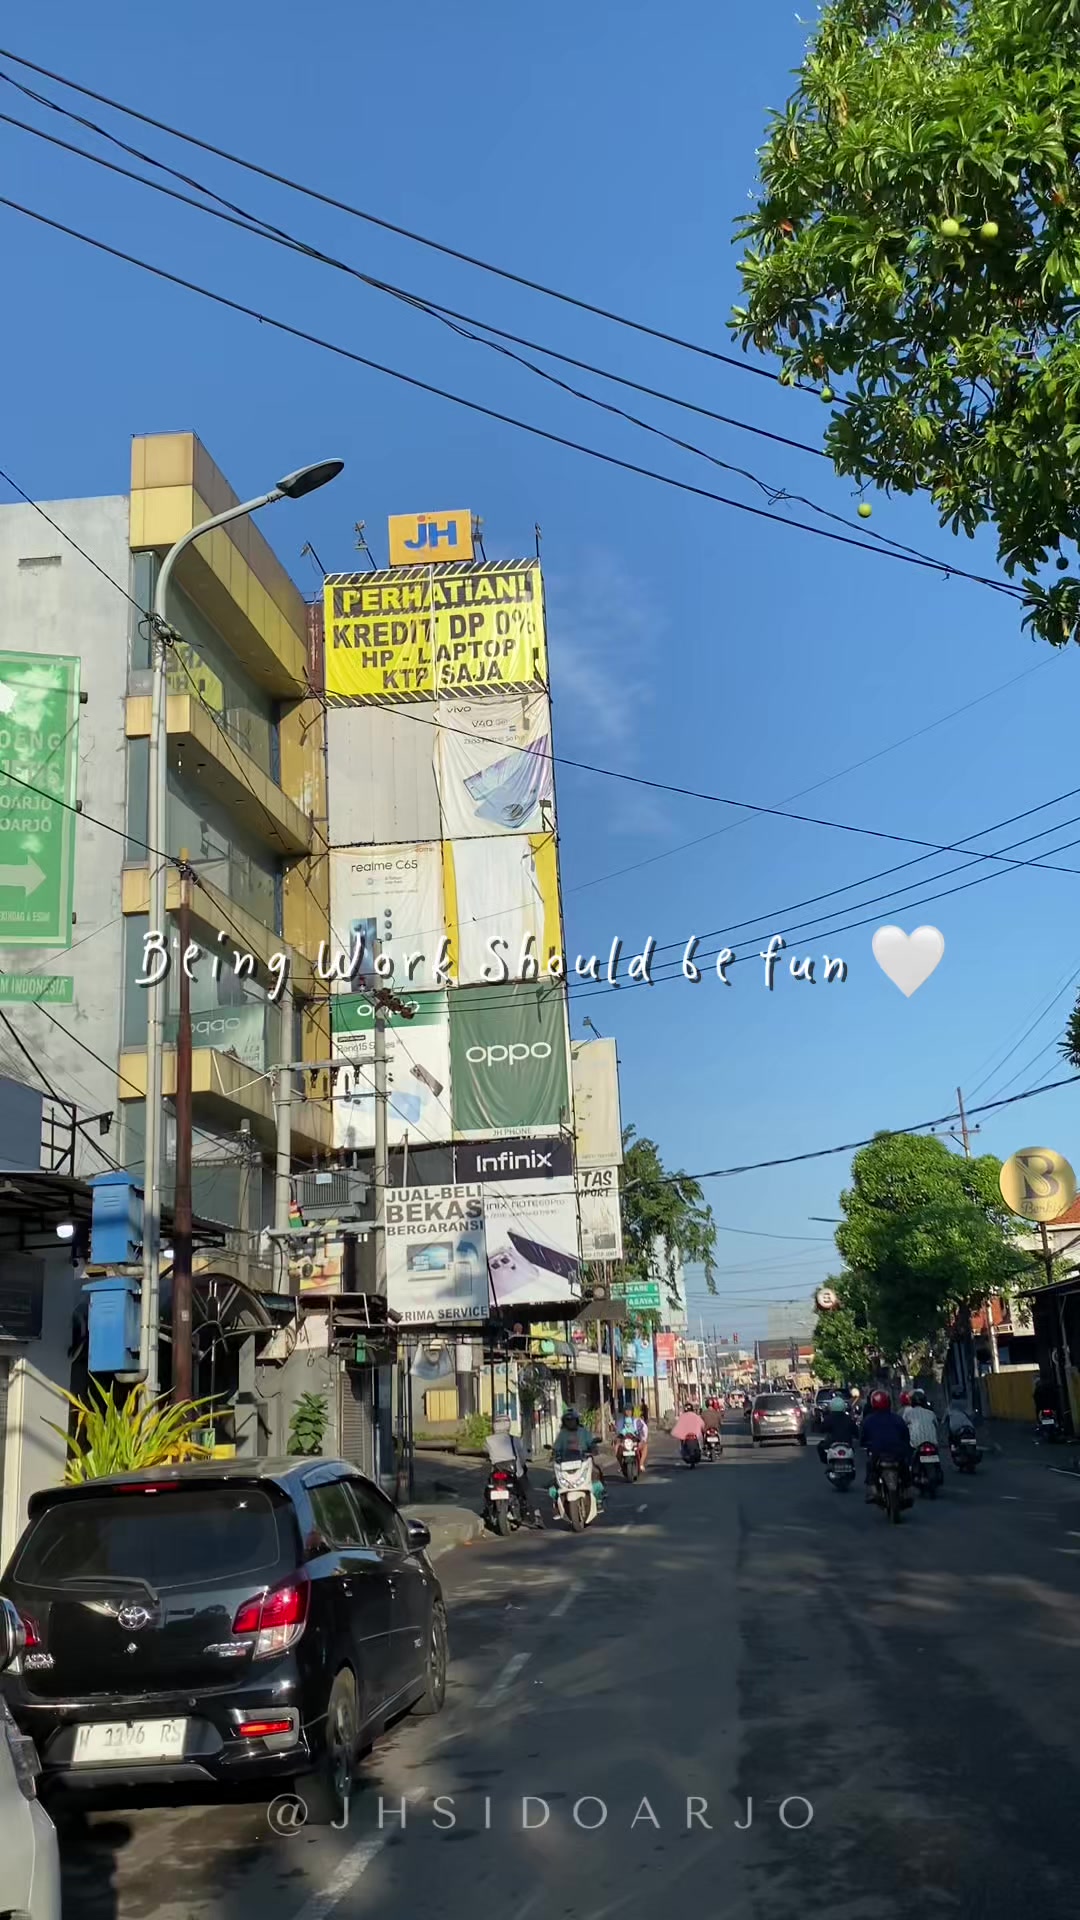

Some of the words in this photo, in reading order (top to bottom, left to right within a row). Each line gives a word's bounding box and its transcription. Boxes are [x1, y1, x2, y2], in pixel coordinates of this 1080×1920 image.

[343, 574, 527, 613] PERHATIAN!
[333, 617, 439, 649] KREDIT
[450, 612, 485, 640] DP
[496, 608, 536, 635] 0%
[362, 650, 394, 668] HP
[418, 639, 515, 665] LAPTOP
[383, 667, 429, 690] KTP
[441, 660, 503, 685] SAJA
[351, 861, 393, 873] realme
[395, 859, 418, 870] C65
[465, 1041, 552, 1067] oppo
[504, 1127, 532, 1136] PHONE
[476, 1149, 553, 1173] Infinix
[581, 1170, 613, 1188] TAS
[386, 1184, 482, 1204] JUAL-BELI
[386, 1199, 482, 1224] BEKAS
[386, 1219, 484, 1237] BERGARANSI
[399, 1308, 435, 1322] ERIMA
[437, 1305, 489, 1320] SERVICE
